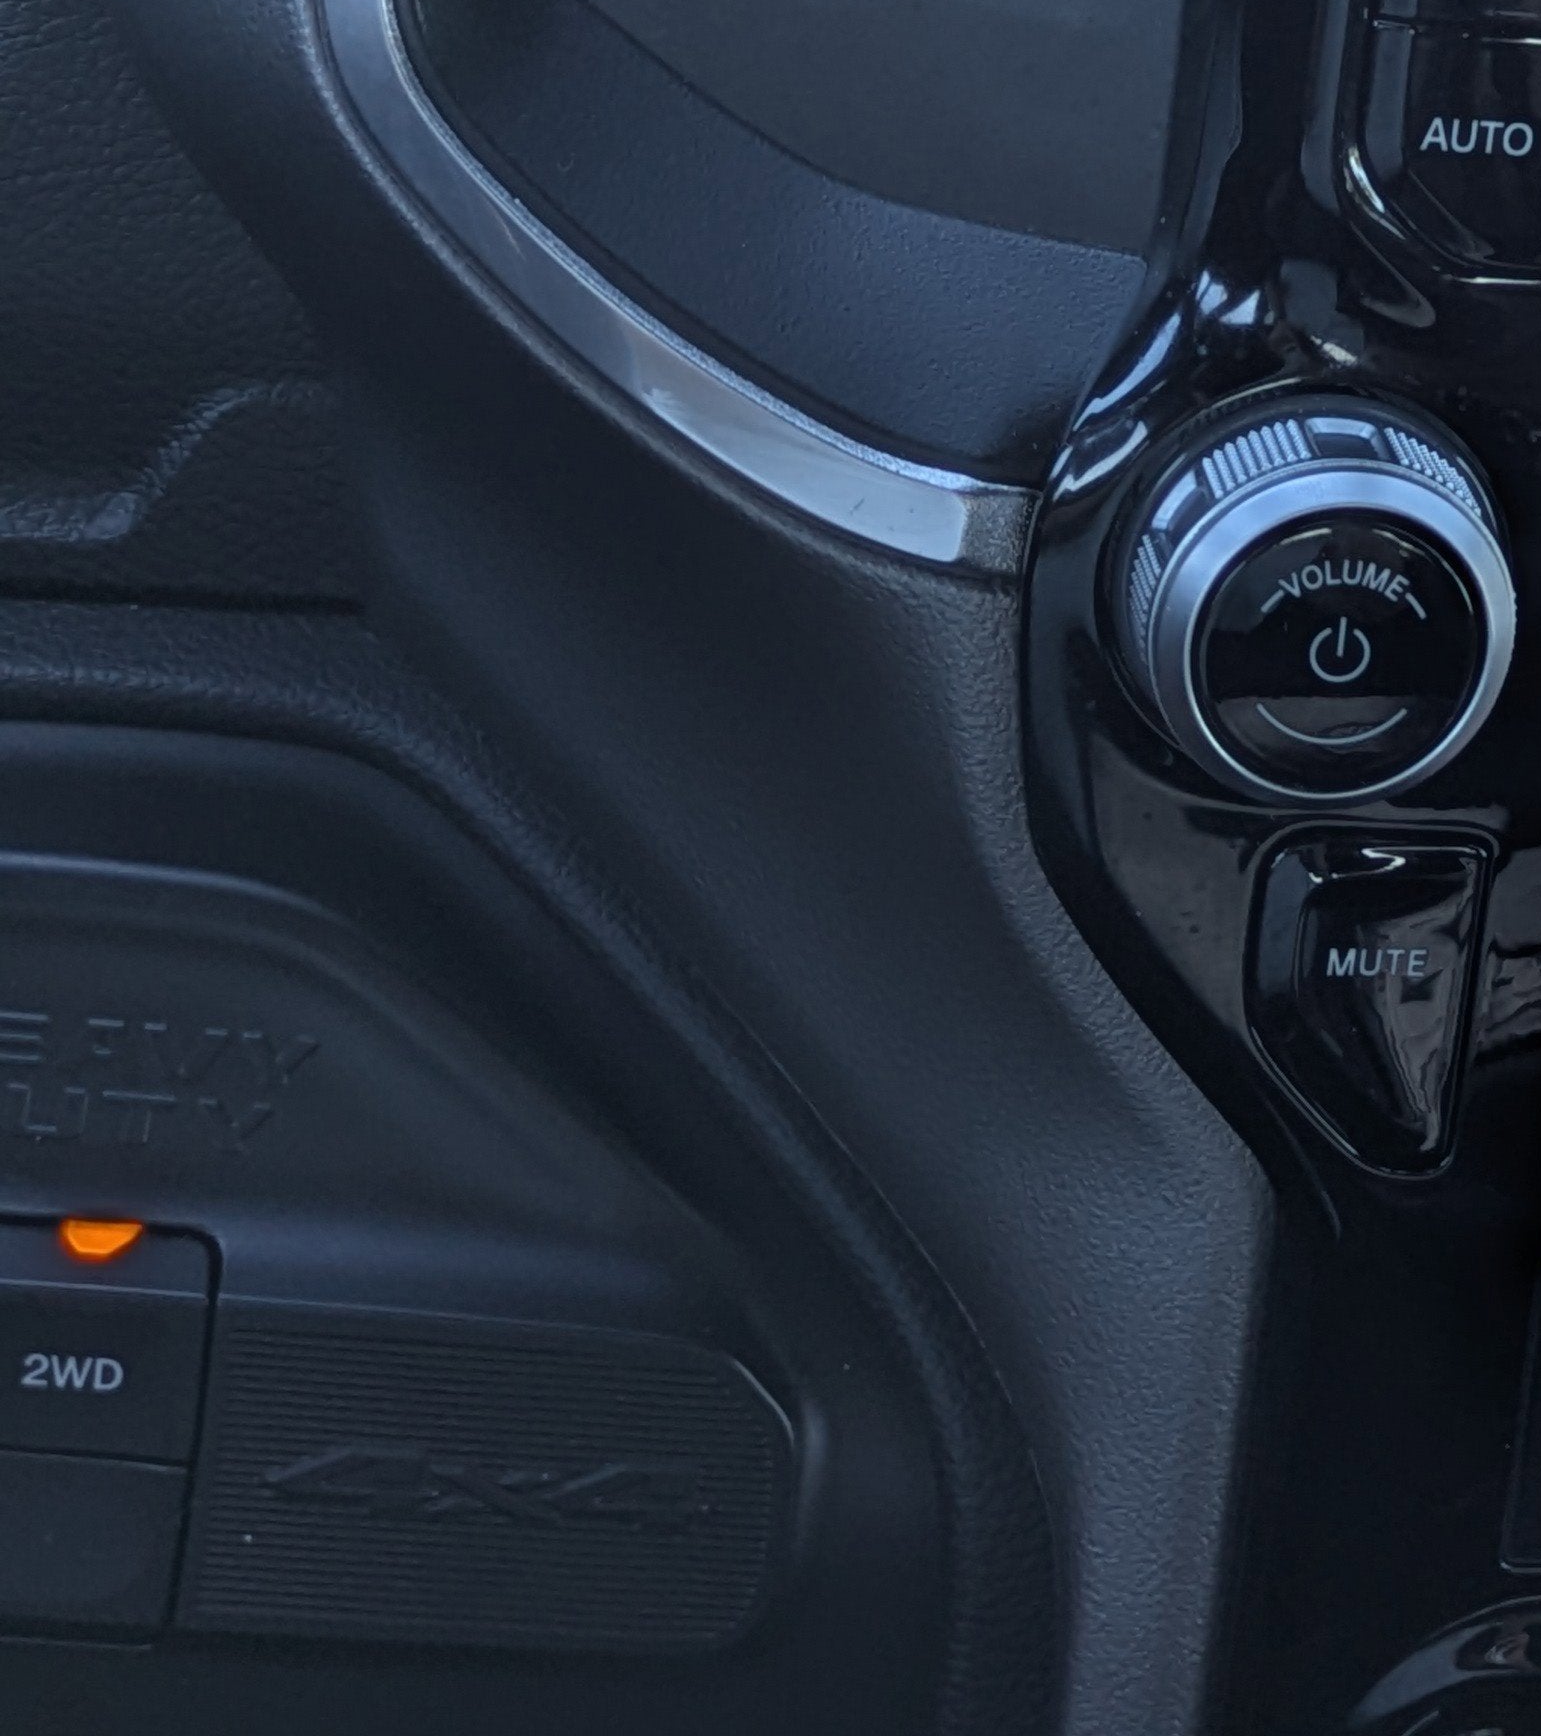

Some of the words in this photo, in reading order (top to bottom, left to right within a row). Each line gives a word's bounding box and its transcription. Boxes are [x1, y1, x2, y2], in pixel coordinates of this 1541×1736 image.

[1420, 116, 1534, 157] AUTO
[1279, 559, 1410, 603] VOLUME
[1326, 947, 1428, 980] MUTE
[20, 1352, 125, 1394] 2WD
